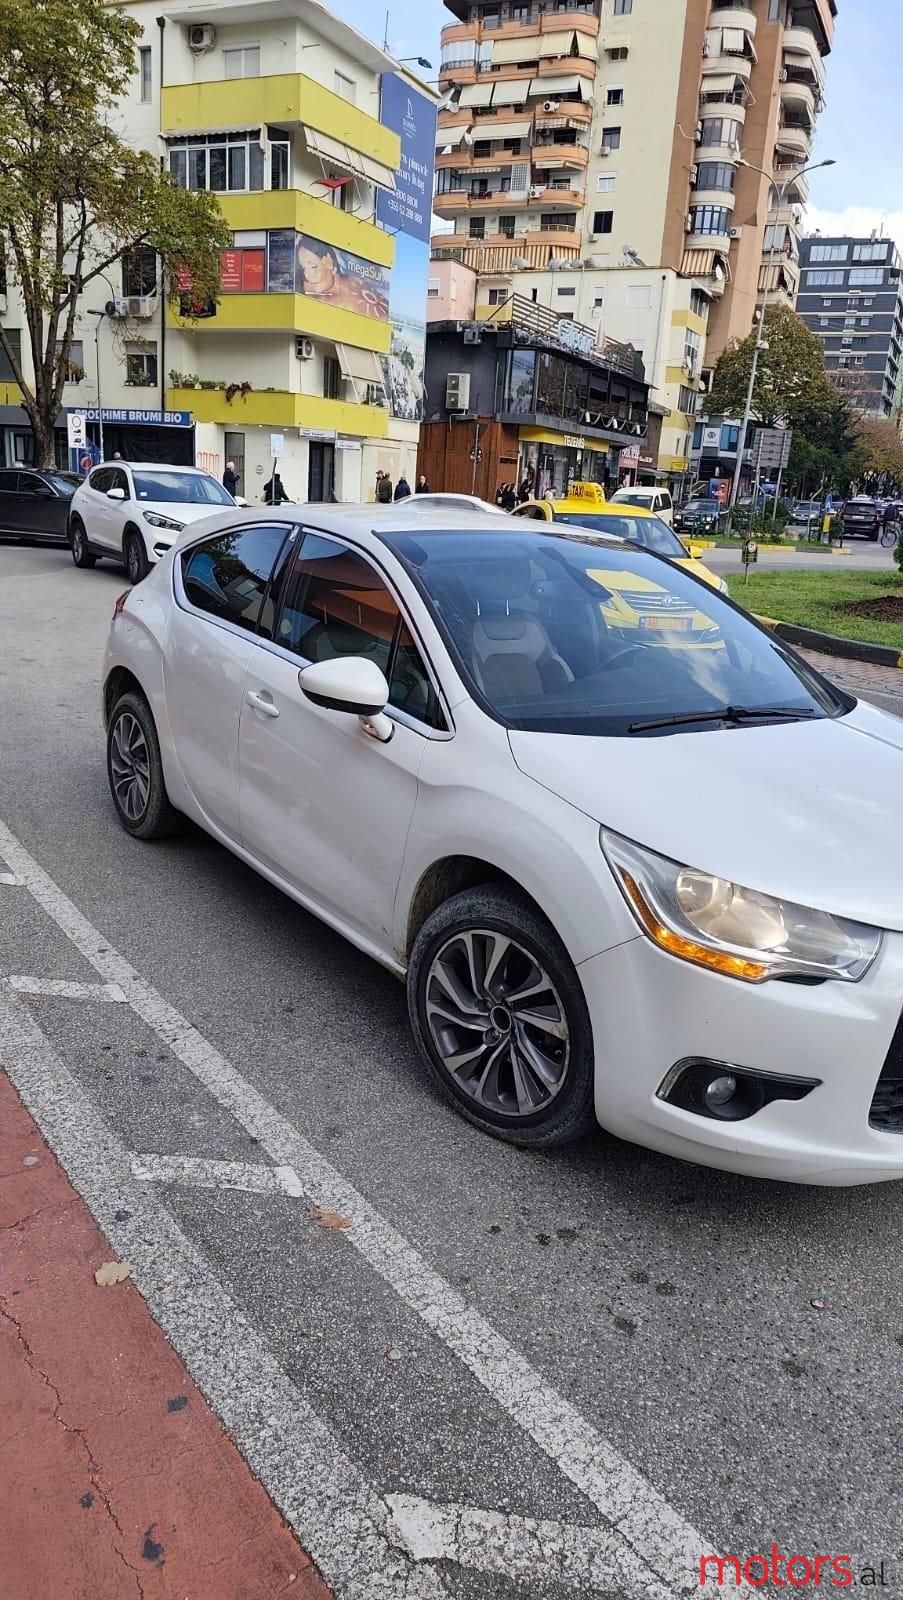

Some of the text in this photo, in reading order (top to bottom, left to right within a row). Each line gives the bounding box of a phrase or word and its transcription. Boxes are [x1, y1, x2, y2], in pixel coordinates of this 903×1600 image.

[347, 260, 385, 282] megaSun
[129, 411, 161, 421] BRUMI
[164, 412, 182, 423] BIO
[564, 434, 585, 449] TEZENIS
[572, 485, 585, 498] TAXI
